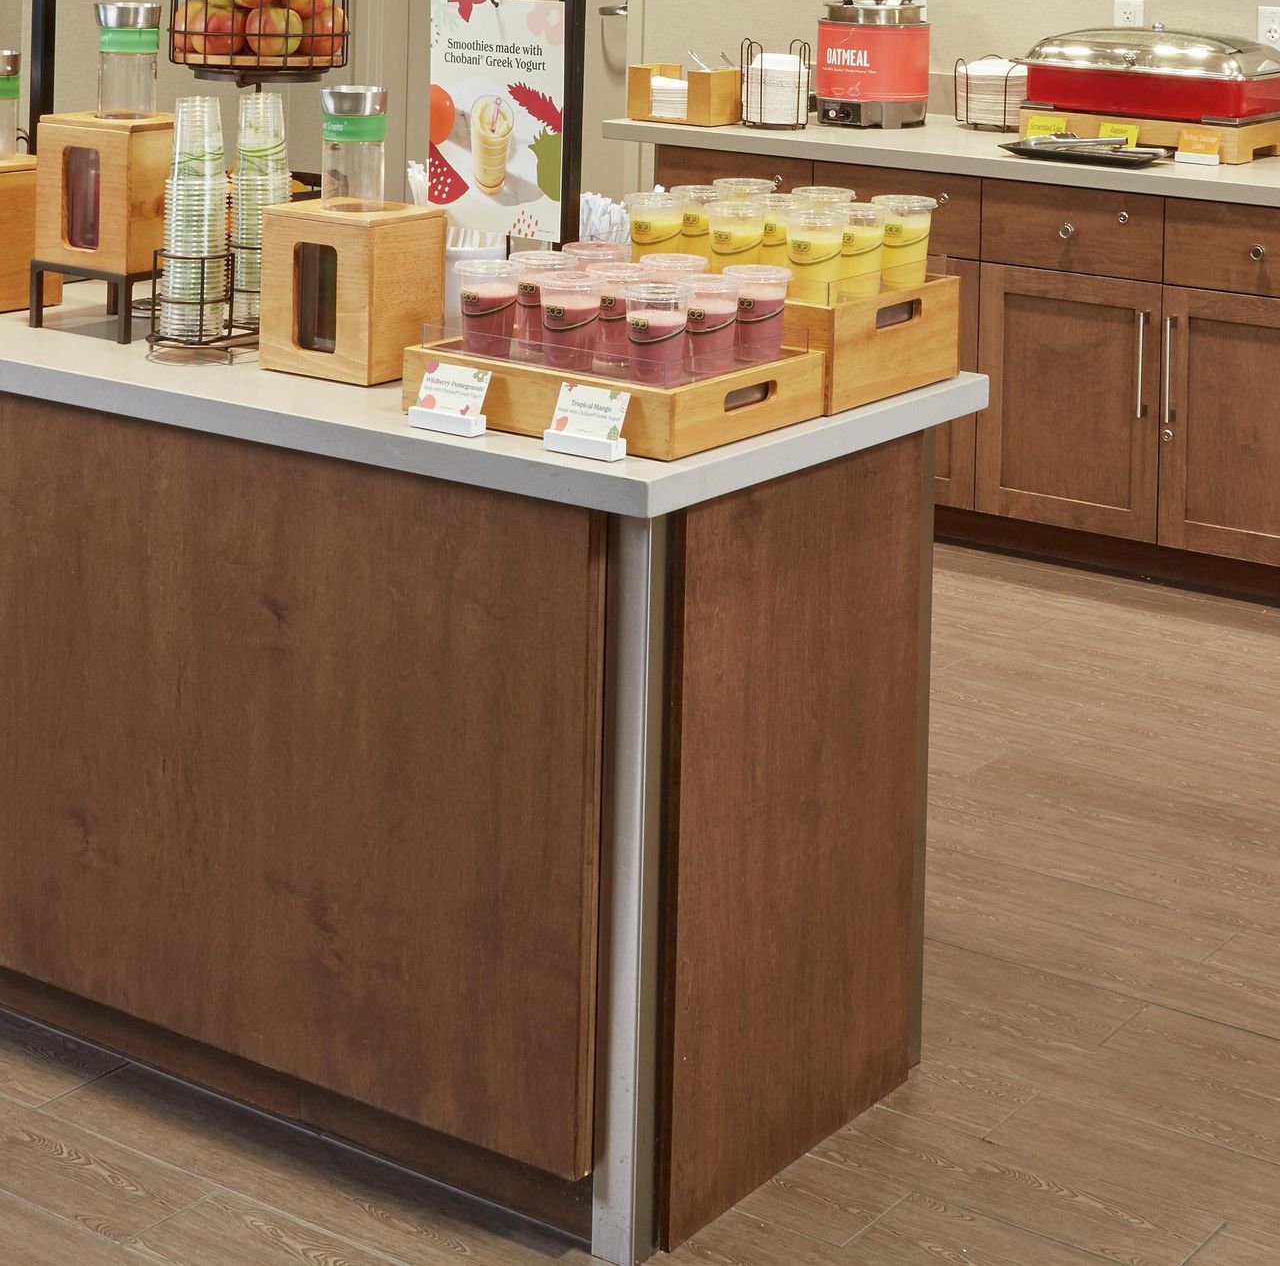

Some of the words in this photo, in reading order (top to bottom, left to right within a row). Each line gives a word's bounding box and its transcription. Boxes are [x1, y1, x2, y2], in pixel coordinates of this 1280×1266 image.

[447, 38, 494, 52] Smoothies
[495, 43, 520, 54] made
[522, 44, 543, 56] with
[485, 55, 513, 68] Greek
[515, 57, 546, 72] Yogurt
[826, 47, 870, 67] OATMEAL
[571, 399, 593, 409] Tropical
[594, 403, 612, 413] Mango
